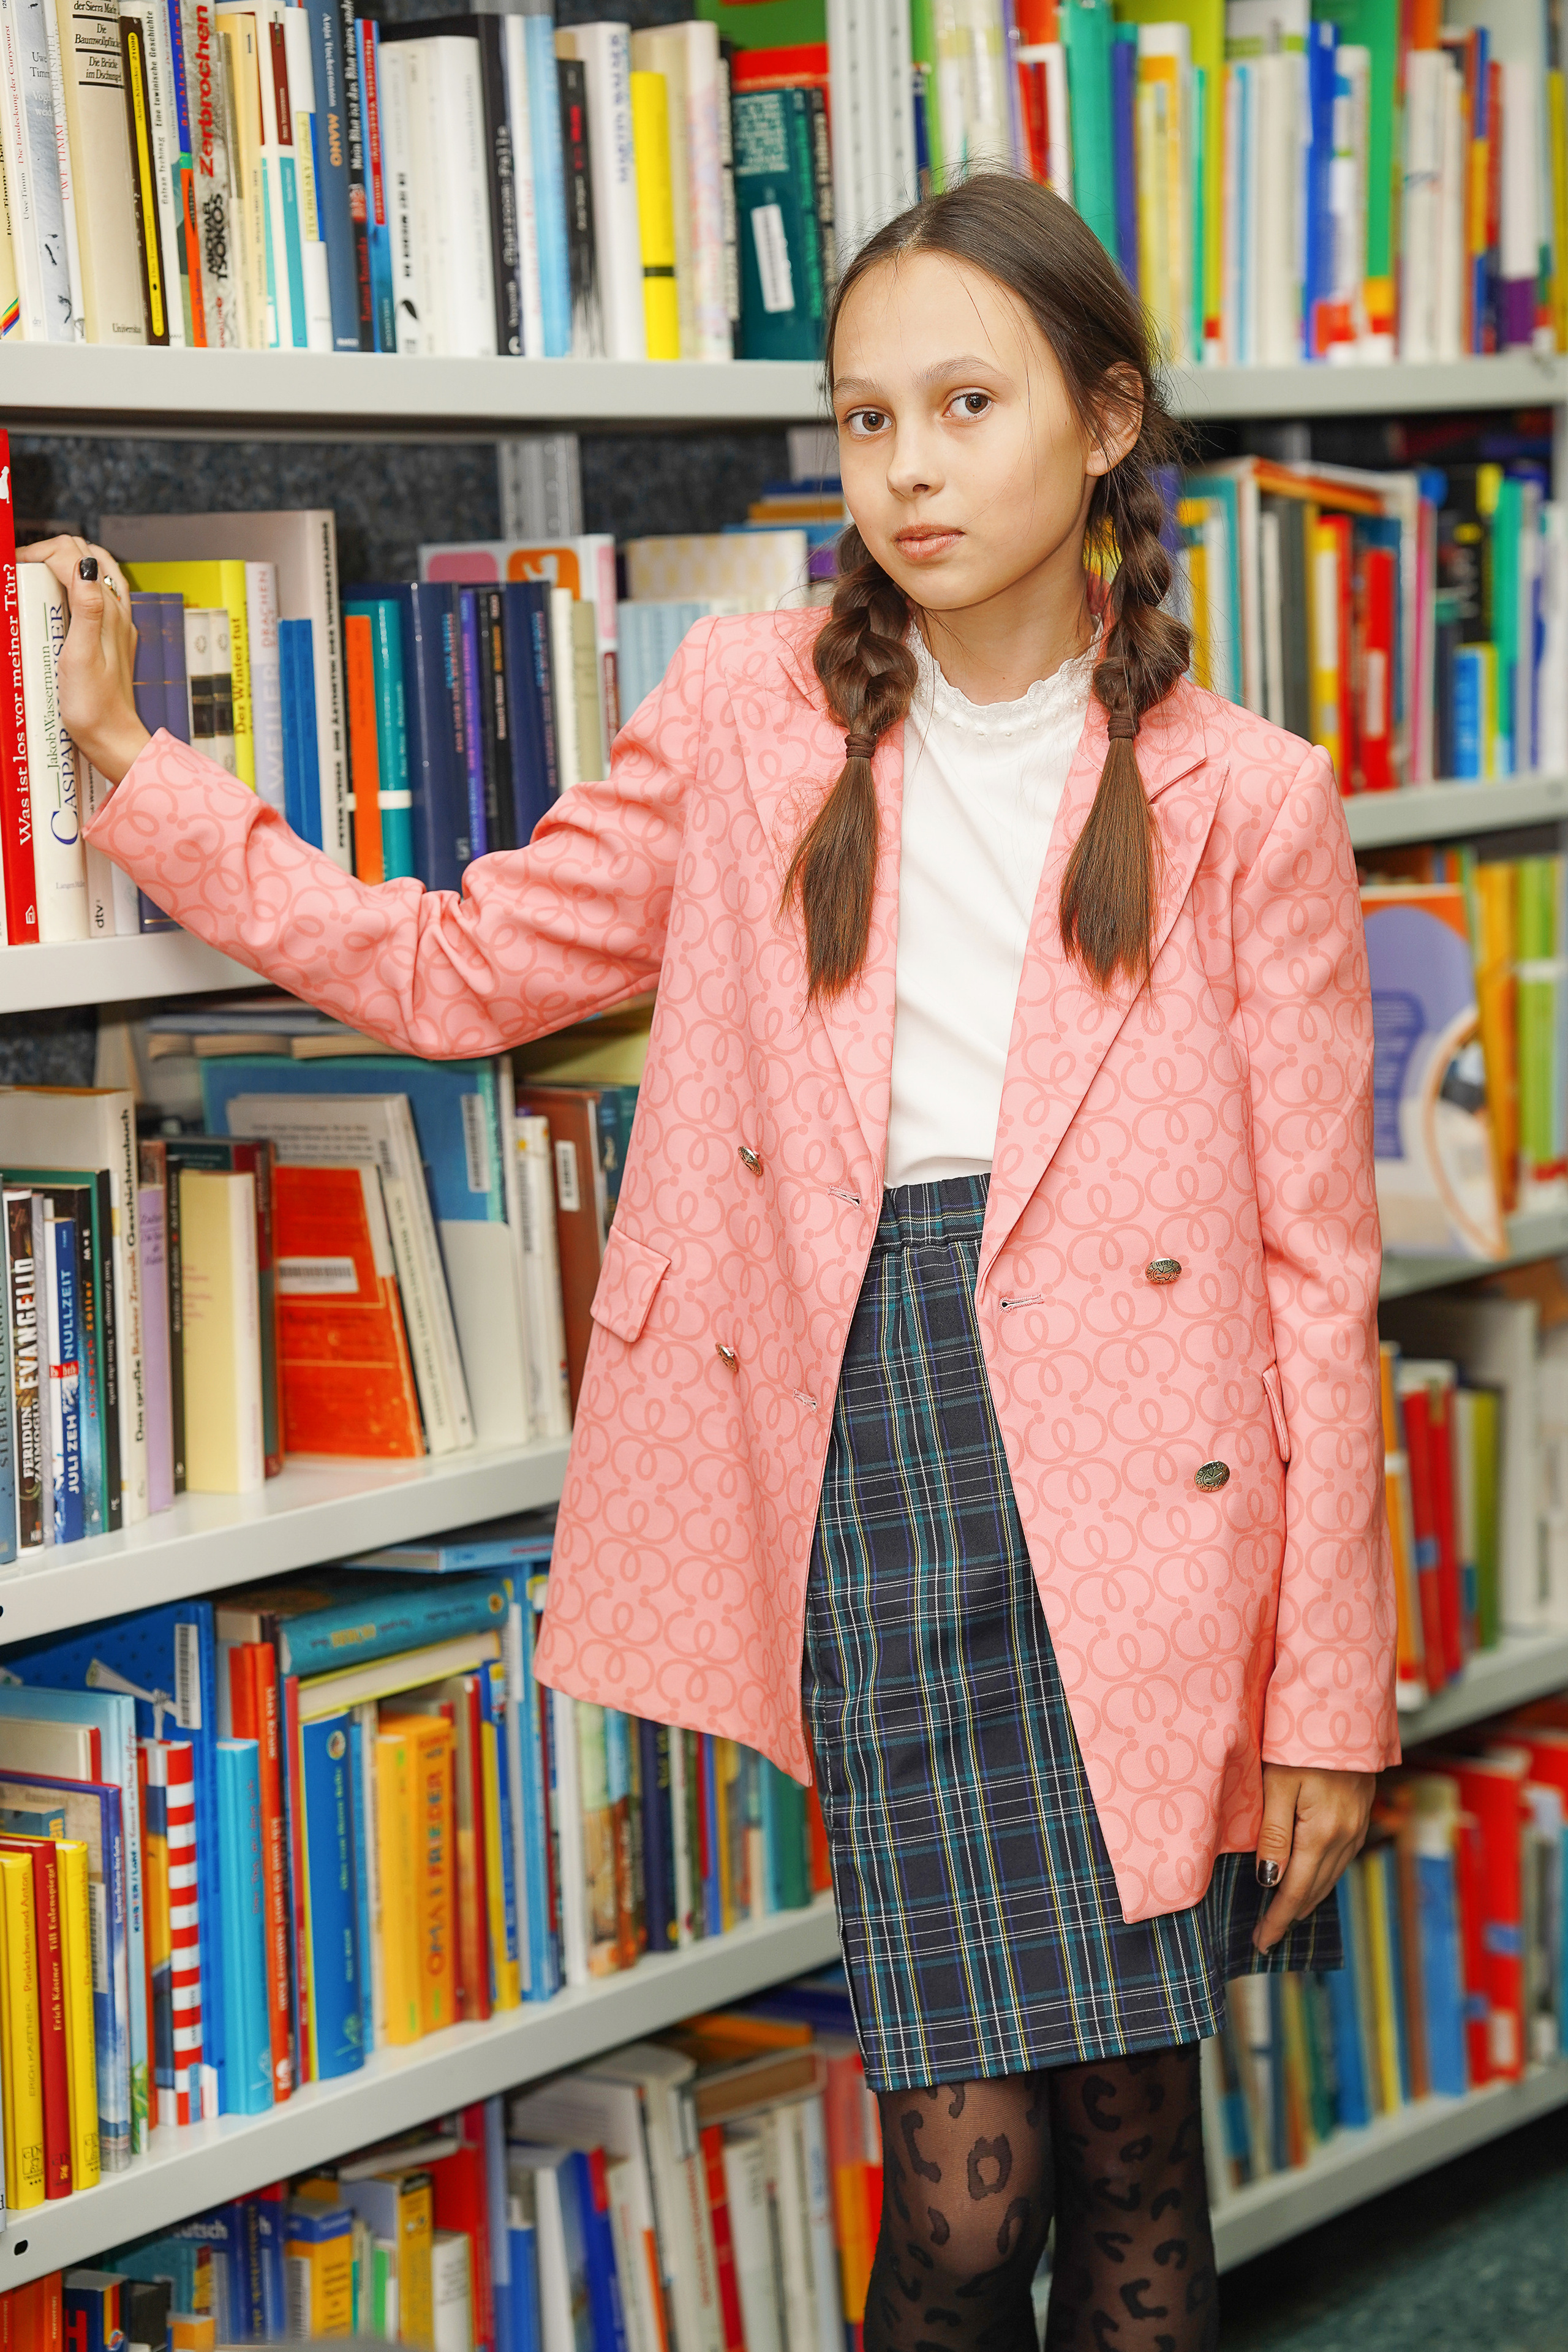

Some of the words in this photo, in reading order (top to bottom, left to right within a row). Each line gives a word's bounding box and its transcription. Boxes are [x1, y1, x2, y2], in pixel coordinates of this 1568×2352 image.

[74, 1, 85, 10] der
[97, 23, 107, 34] Die
[146, 11, 157, 58] Geschichte
[6, 26, 15, 75] Currywurst
[32, 51, 47, 62] Uwe
[89, 56, 100, 67] Die
[344, 57, 357, 80] Blut
[86, 69, 94, 78] im
[195, 5, 213, 178] Zerbrochen
[346, 83, 358, 102] das
[12, 94, 22, 146] Entdeckung
[348, 119, 361, 142] Blut
[55, 125, 66, 162] TIMM
[328, 113, 343, 167] MANO
[60, 170, 70, 200] UWE
[203, 200, 216, 274] MICHAEL
[209, 194, 228, 282] TSOKOS
[4, 564, 17, 611] Tür?
[231, 617, 242, 639] tut
[258, 570, 272, 648] DRACHEN
[8, 616, 22, 688] meiner
[42, 646, 56, 732] Wassermann
[233, 646, 244, 703] Winter
[14, 693, 24, 727] vor
[235, 706, 246, 734] Der
[12, 731, 27, 763] los
[45, 733, 60, 769] Jakob
[17, 767, 29, 793] ist
[50, 728, 78, 845] CASPAR
[18, 797, 31, 845] Was
[94, 904, 104, 929] dtv
[121, 1109, 136, 1247] Geschichtenbuch
[14, 1257, 39, 1390] EVANGELIO
[60, 1269, 74, 1359] NULLZEIT
[20, 1406, 34, 1479] FERIDUN
[66, 1414, 78, 1453] ZEH
[135, 1412, 143, 1442] Das
[67, 1455, 80, 1494] JULI
[20, 1872, 29, 1907] Anton
[45, 1863, 57, 1930] Eulenspiegel
[20, 1910, 29, 1932] und
[48, 1932, 59, 1952] Till
[22, 1933, 31, 1992] Pünktchen
[51, 1962, 61, 2001] Kästner
[51, 2003, 61, 2031] Erich
